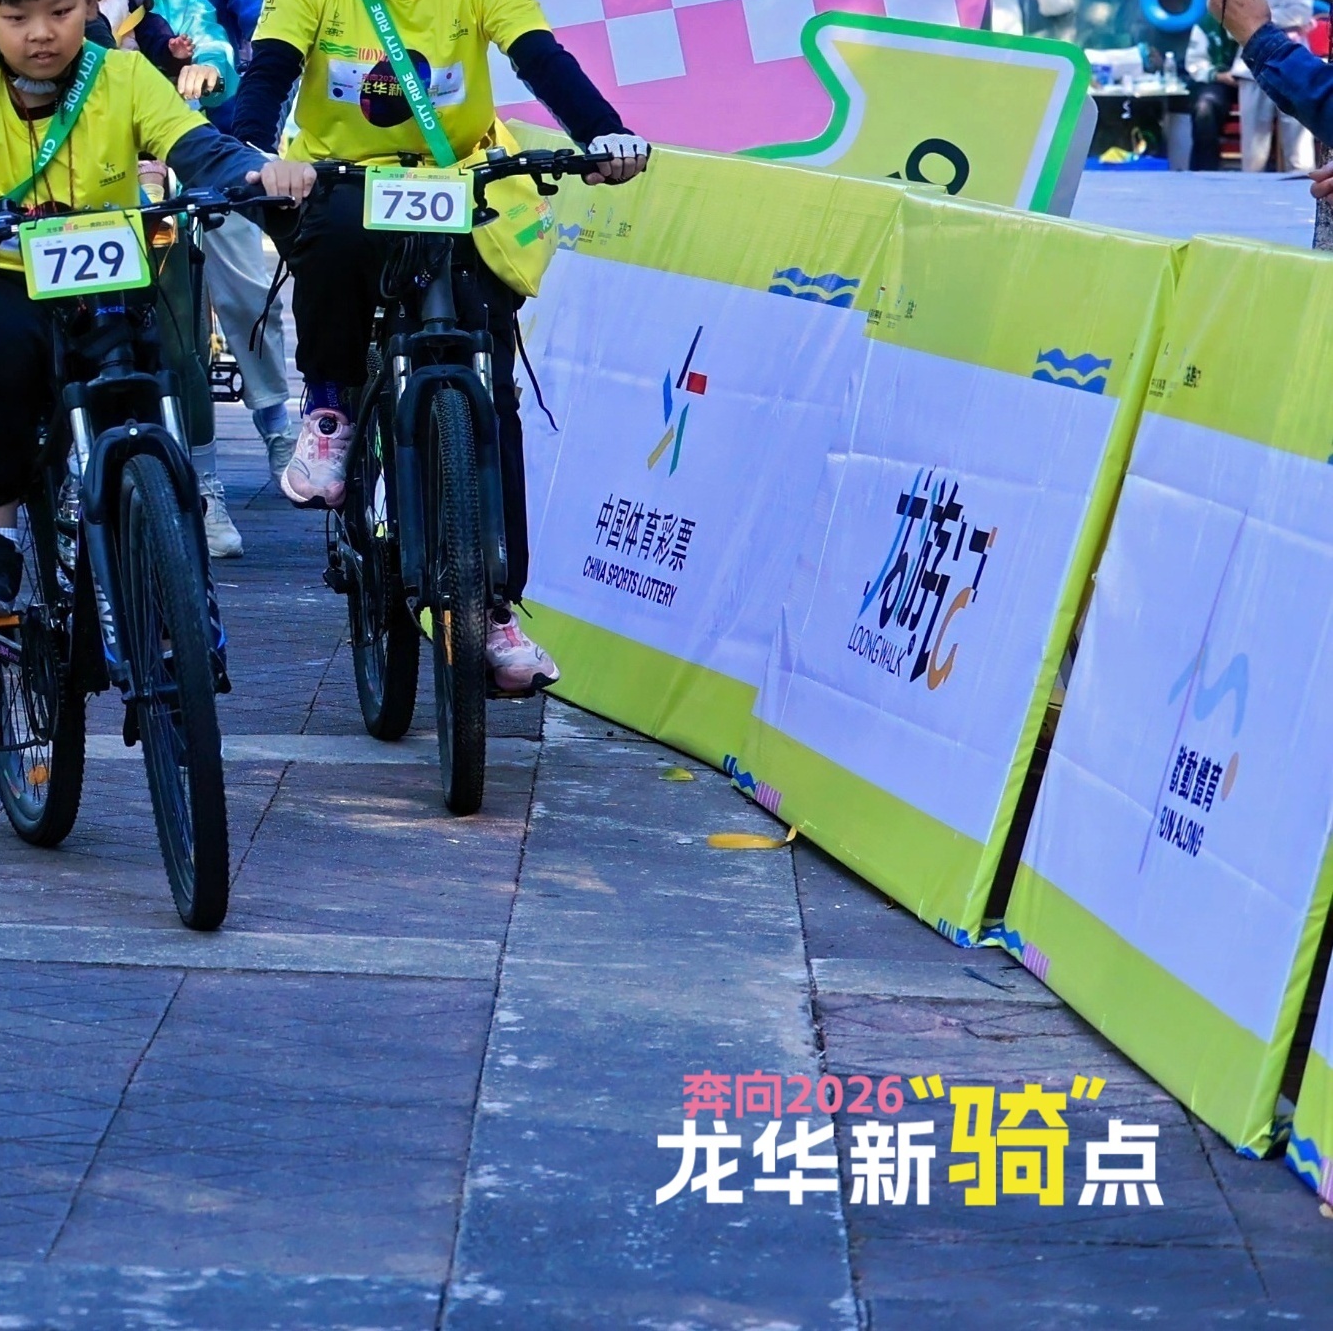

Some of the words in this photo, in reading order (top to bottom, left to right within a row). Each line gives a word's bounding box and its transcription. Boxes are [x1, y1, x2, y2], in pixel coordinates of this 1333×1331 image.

[370, 3, 392, 33] RIDE
[384, 33, 404, 62] CITY
[78, 51, 98, 80] CITY
[63, 79, 85, 112] RIDE
[402, 72, 424, 102] RIDE
[415, 101, 436, 131] CITY
[382, 189, 454, 222] 730
[43, 240, 125, 285] 729
[595, 493, 697, 572] 中国体育彩票
[582, 555, 608, 583] CHINA
[606, 563, 640, 595] SPORTS
[636, 574, 678, 608] LOTTERY
[847, 623, 884, 665] LOONG
[879, 637, 907, 678] WALK
[1171, 815, 1205, 858] ALONG
